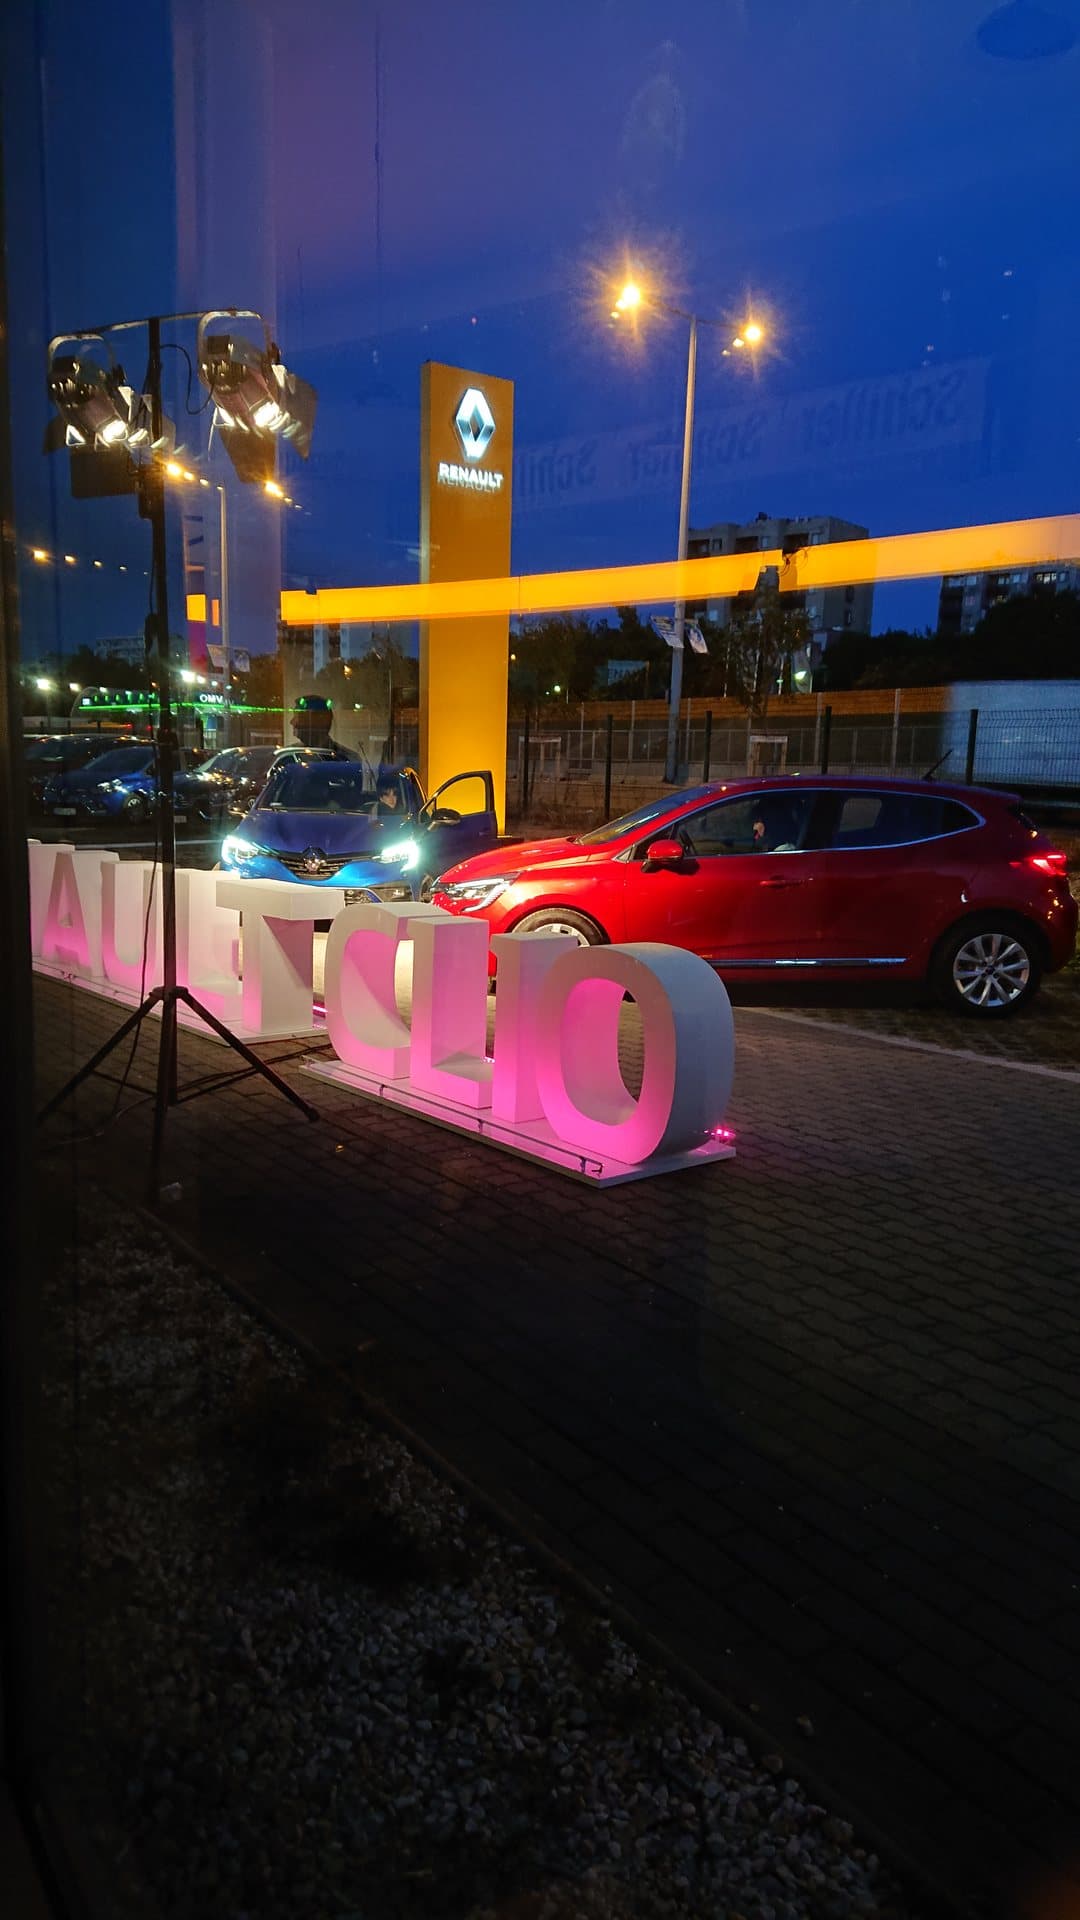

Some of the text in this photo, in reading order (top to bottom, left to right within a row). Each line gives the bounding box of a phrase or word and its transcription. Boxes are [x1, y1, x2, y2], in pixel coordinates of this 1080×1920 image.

[438, 462, 504, 491] RENAULT
[199, 693, 223, 704] OMV
[325, 901, 734, 1165] CLIO
